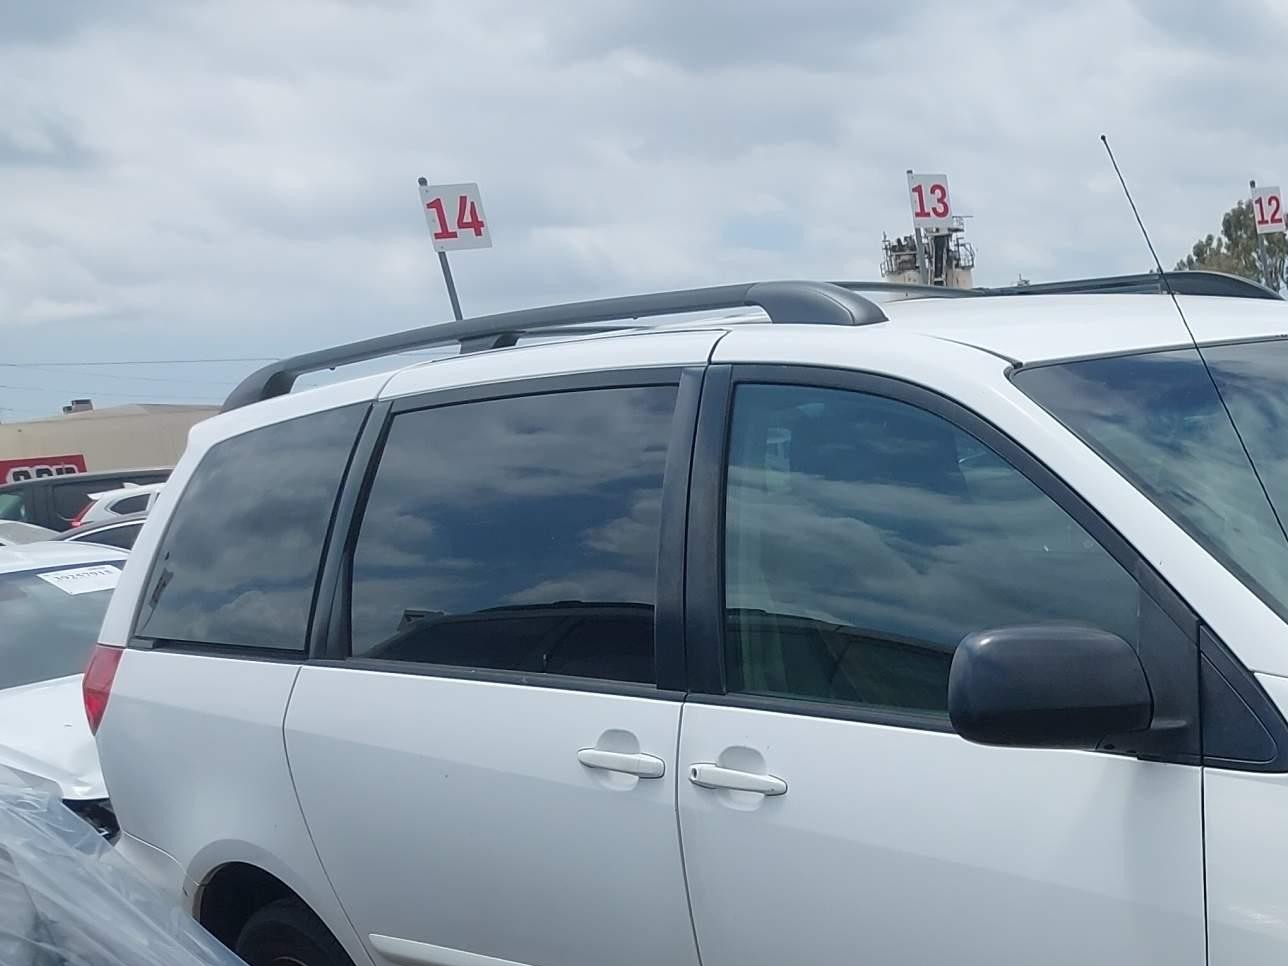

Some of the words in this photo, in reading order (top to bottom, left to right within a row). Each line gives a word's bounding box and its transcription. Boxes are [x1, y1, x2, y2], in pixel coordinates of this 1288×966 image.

[426, 195, 485, 240] 14
[911, 184, 949, 218] 13
[1254, 195, 1283, 225] 12
